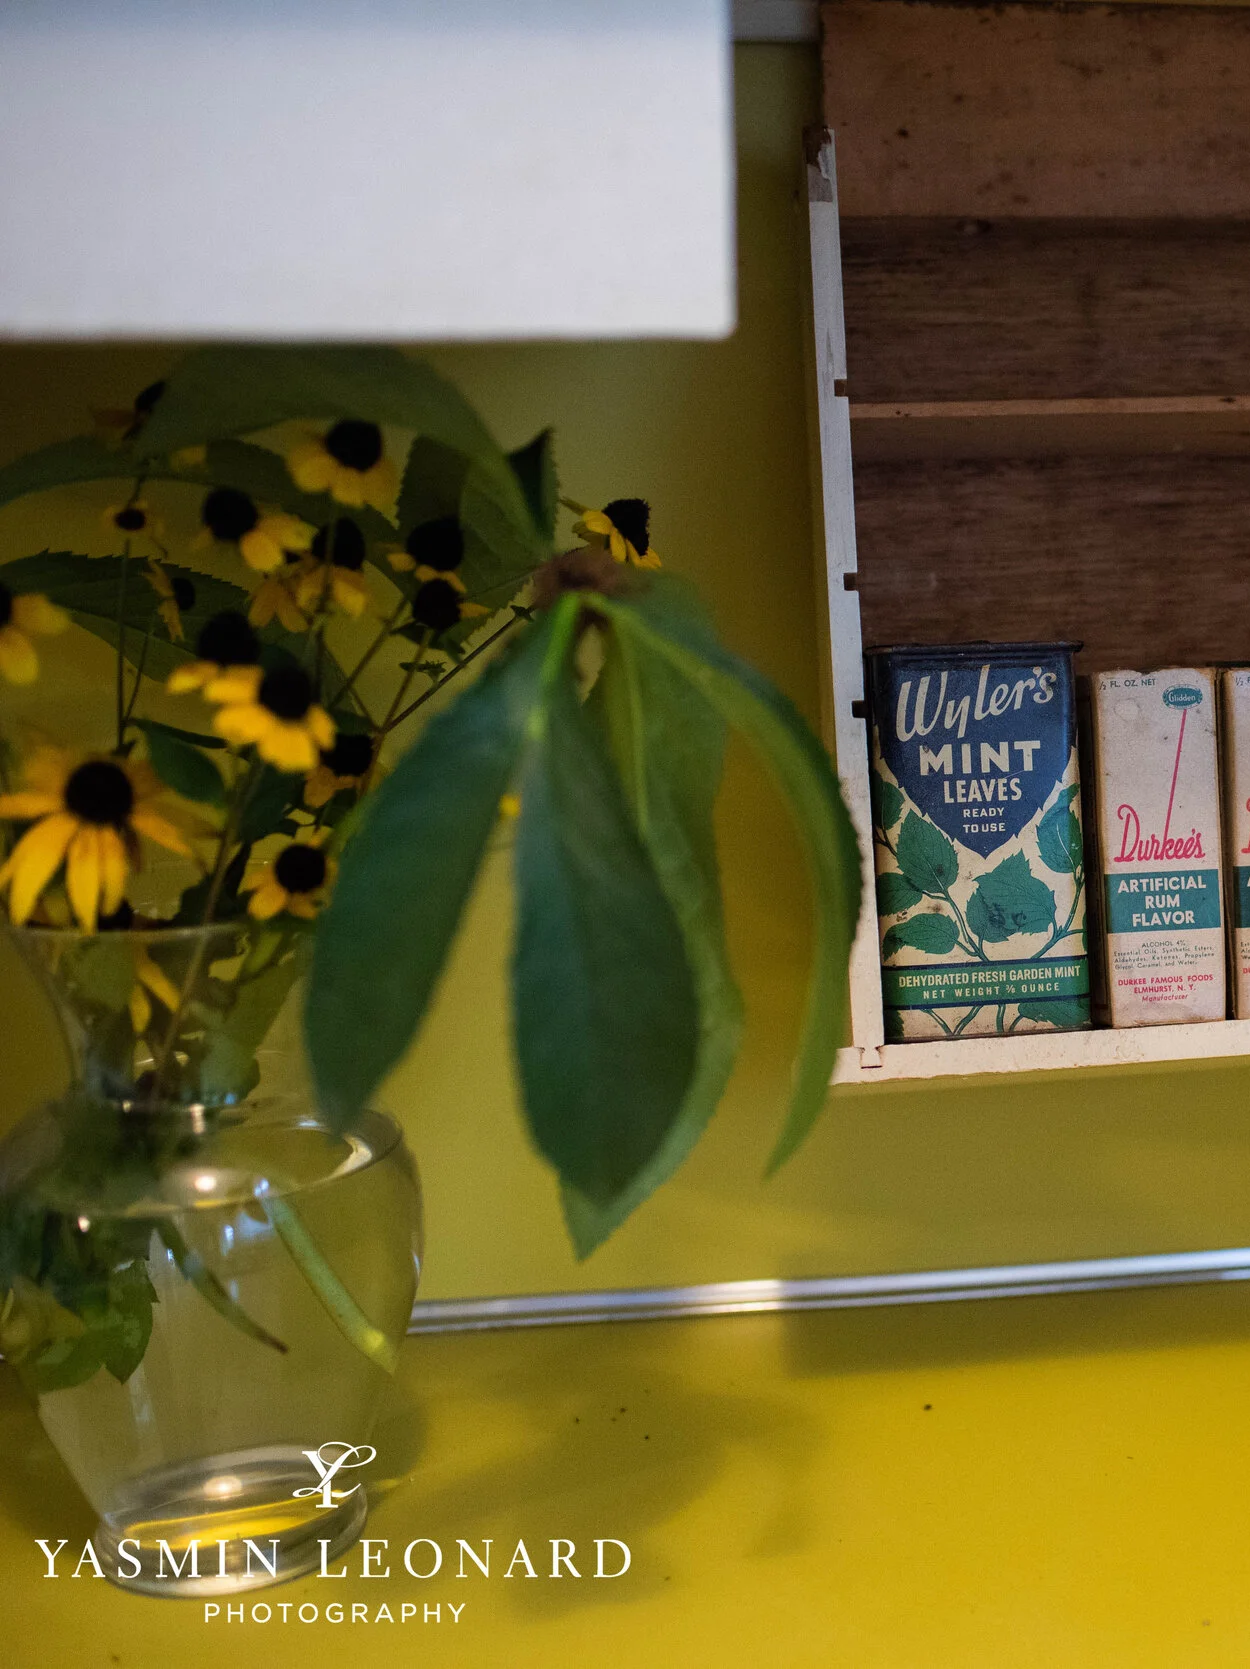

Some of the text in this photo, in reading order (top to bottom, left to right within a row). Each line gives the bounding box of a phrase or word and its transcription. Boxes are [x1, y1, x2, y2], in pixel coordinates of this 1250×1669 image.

[896, 664, 1057, 743] Wyler's
[1168, 692, 1196, 703] Glidden
[919, 740, 1041, 777] MINT
[944, 778, 1022, 804] LEAVES
[962, 806, 1005, 818] READY
[963, 822, 1006, 834] TO USE
[1117, 875, 1207, 894] ARTIFICIAL
[1145, 894, 1180, 910] RUM
[1132, 910, 1195, 927] FLAVOR
[1113, 948, 1141, 957] Essential
[1162, 946, 1191, 954] Synthetic
[1184, 951, 1215, 959] Propylene
[898, 965, 1081, 988] DEHYDRATED FRESH GARDEN MINT
[1118, 974, 1214, 986] DURKEE FAMOUS FOODS
[923, 990, 946, 999] NET
[954, 986, 1001, 997] WEIGHT
[1021, 982, 1060, 993] OUNCE
[1133, 986, 1175, 994] ELMHURST,
[1142, 993, 1188, 1002] Manufacturer
